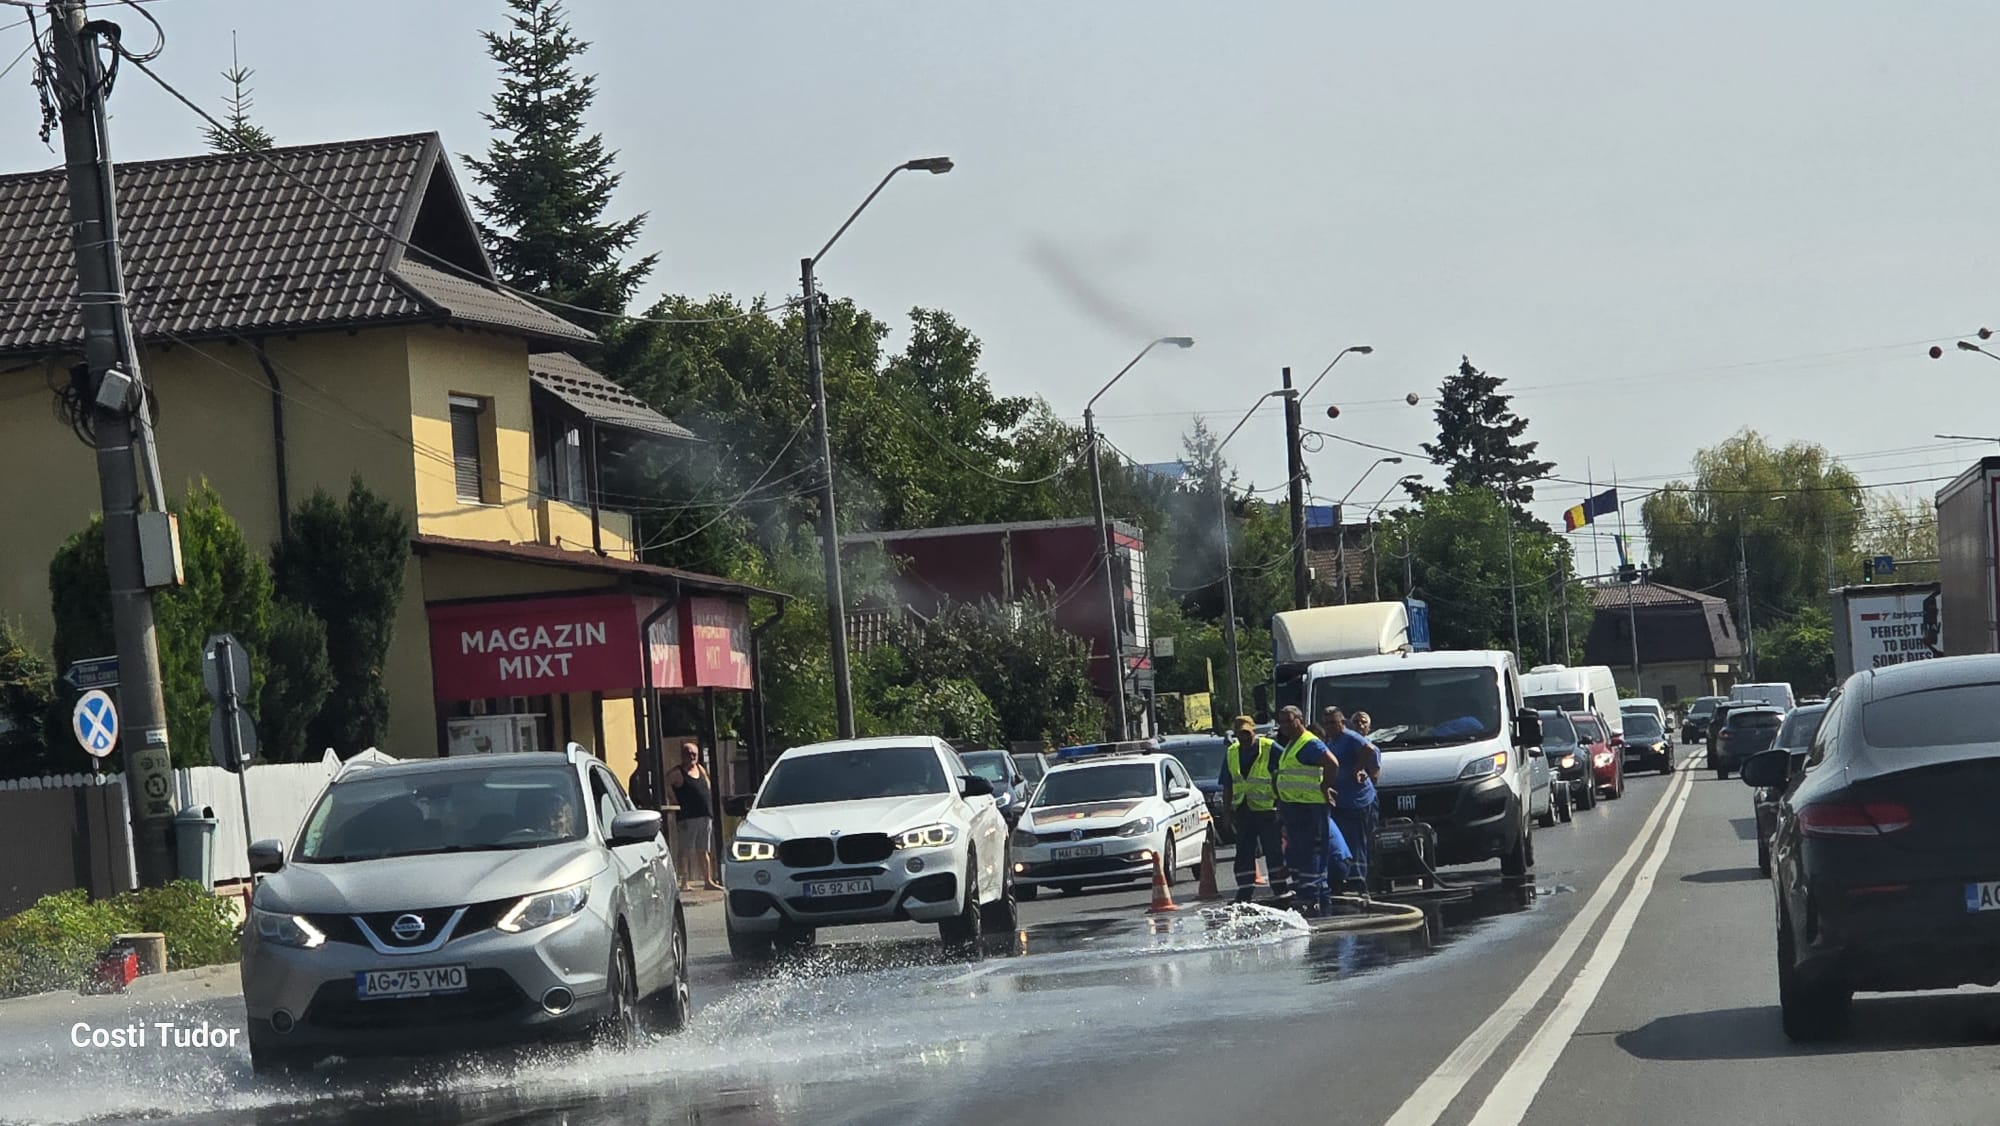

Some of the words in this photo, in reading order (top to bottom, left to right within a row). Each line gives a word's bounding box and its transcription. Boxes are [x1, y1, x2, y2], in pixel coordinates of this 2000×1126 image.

[461, 621, 606, 654] MAGAZIN
[1870, 623, 1919, 639] PERFECT
[1882, 639, 1898, 653] TO
[1900, 637, 1929, 651] BUR
[499, 652, 573, 681] MIXT
[1872, 652, 1905, 668] SOME
[1397, 794, 1416, 811] FIAT
[811, 883, 826, 896] AG
[829, 883, 843, 894] 92
[368, 973, 391, 993] AG
[398, 971, 421, 990] 75
[424, 968, 462, 988] YMO
